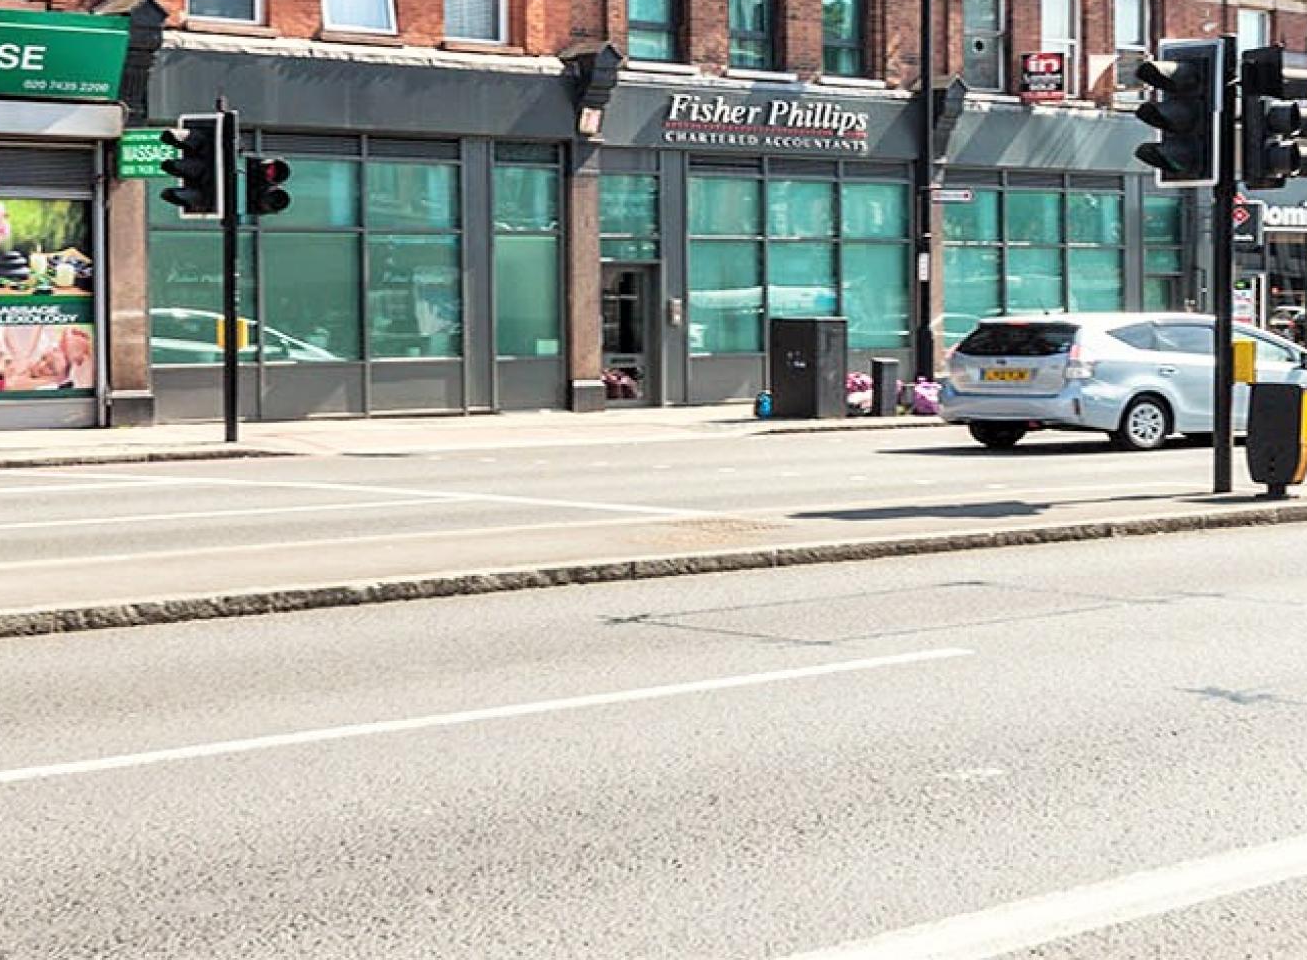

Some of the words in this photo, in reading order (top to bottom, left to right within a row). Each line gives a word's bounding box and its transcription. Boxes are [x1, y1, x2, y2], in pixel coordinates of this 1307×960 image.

[23, 79, 47, 90] 020
[669, 93, 762, 125] Fisher
[769, 99, 869, 137] Phillips
[665, 130, 759, 146] CHARTERED
[765, 136, 869, 153] ACCOUNTANTS
